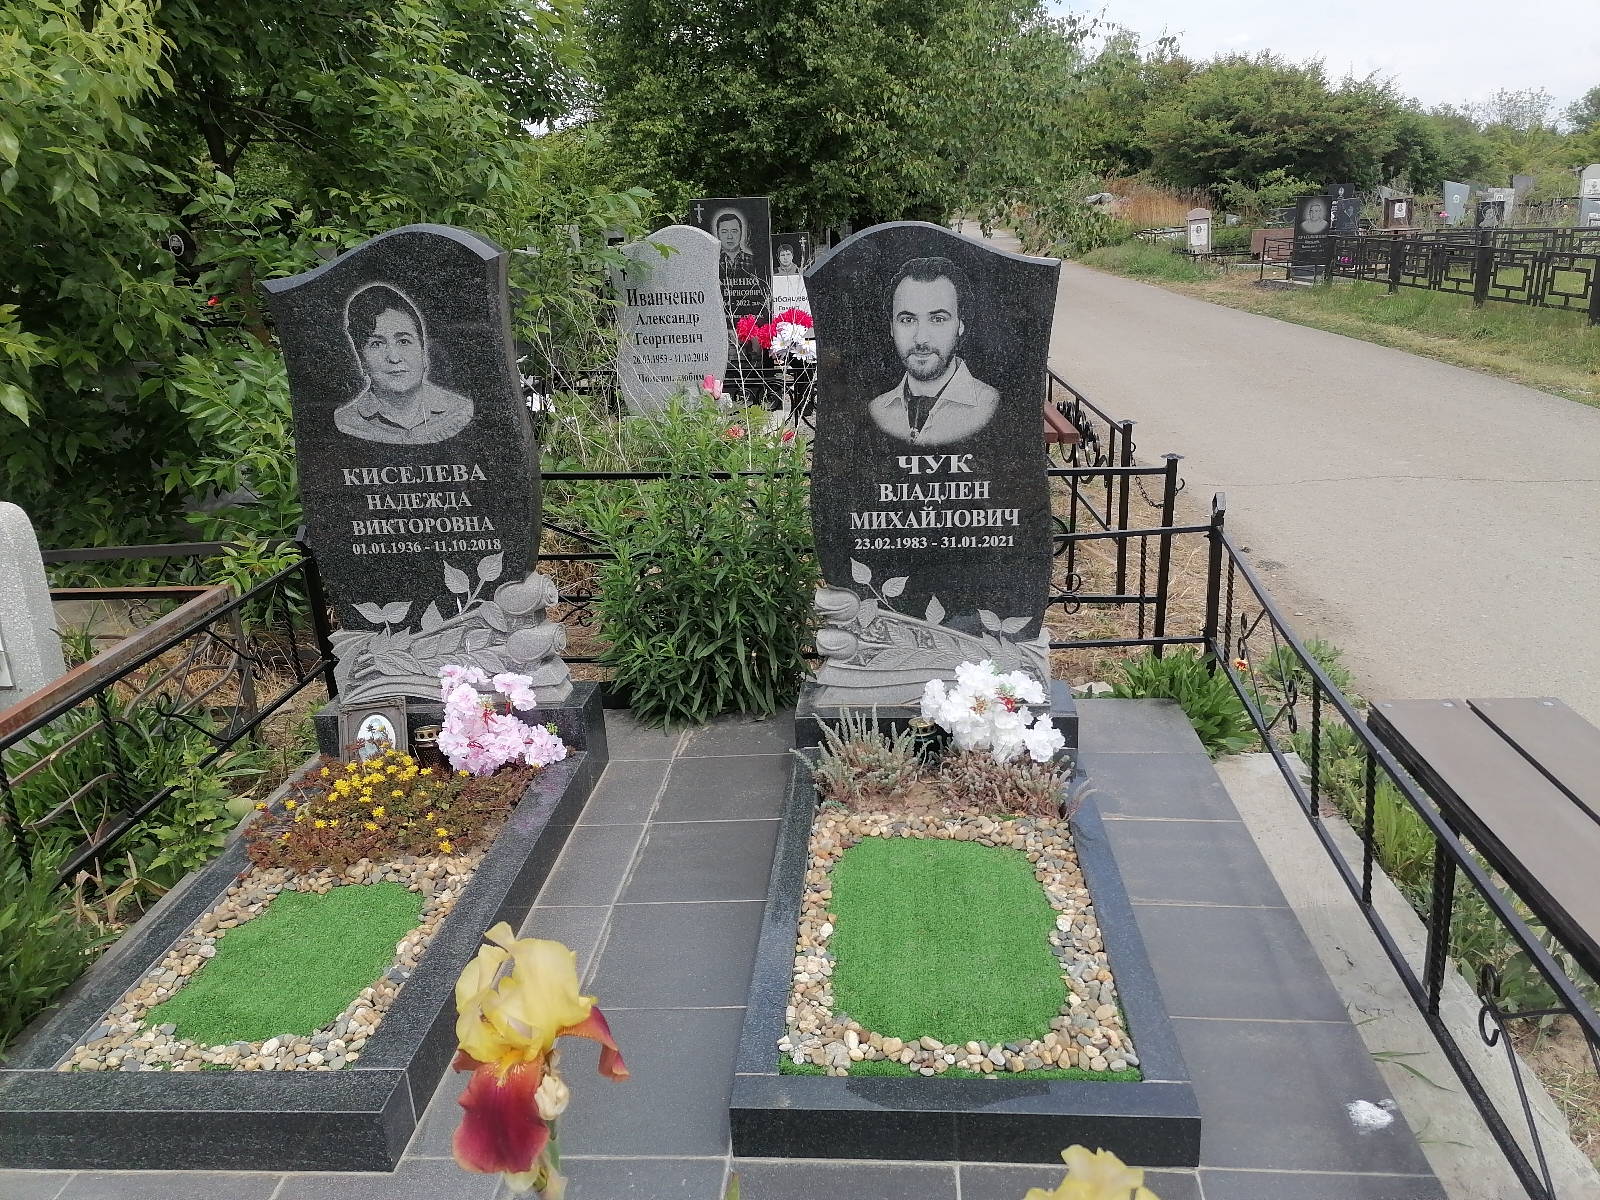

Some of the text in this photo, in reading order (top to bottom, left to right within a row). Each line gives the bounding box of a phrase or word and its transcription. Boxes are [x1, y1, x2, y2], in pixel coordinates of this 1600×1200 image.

[626, 288, 705, 307] Иванченко
[736, 299, 751, 307] 2022
[635, 311, 700, 327] Александр
[635, 332, 703, 348] Георгиевич
[674, 353, 709, 363] 11.10.2018
[896, 453, 974, 475] ЧУК
[341, 463, 488, 486] КИСЕЛЕВА
[365, 491, 473, 512] НАДЕЖДА
[878, 481, 991, 505] ВЛАДЛЕН
[351, 516, 496, 536] ВИКТОРОВНА
[849, 505, 1021, 530] МИХАЙЛОВИЧ
[352, 541, 422, 555] 01.01.1936
[433, 538, 502, 553] 11.10.2018
[854, 537, 928, 550] 23.02.1983
[940, 535, 1015, 549] 31.01.2021
